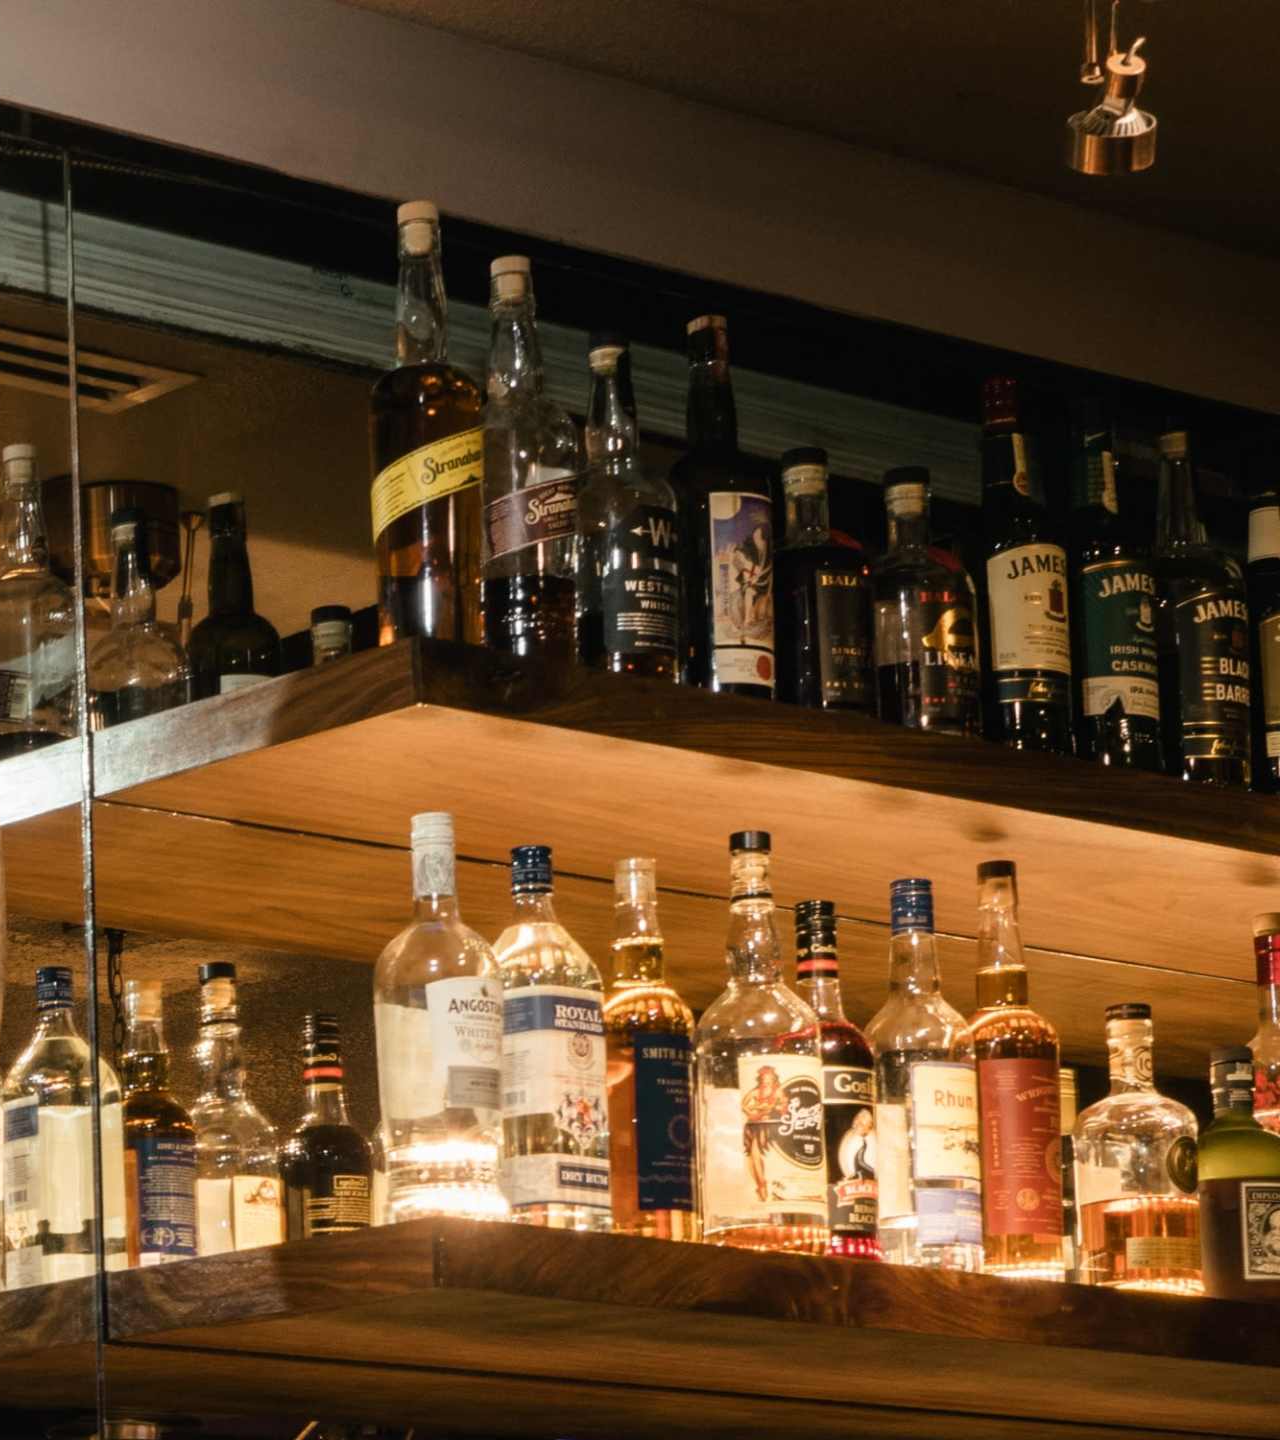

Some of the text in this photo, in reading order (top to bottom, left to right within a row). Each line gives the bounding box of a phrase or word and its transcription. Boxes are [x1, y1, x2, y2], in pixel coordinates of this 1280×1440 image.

[649, 517, 671, 547] W
[1008, 554, 1067, 580] JAMES
[1098, 573, 1155, 598] JAMES
[1194, 600, 1248, 624] JAMES
[449, 998, 502, 1014] ANGOST
[554, 1004, 602, 1023] ROYAL
[554, 1019, 603, 1033] STANDARD
[642, 1046, 675, 1060] SMITH
[561, 1169, 609, 1185] DRY RUM
